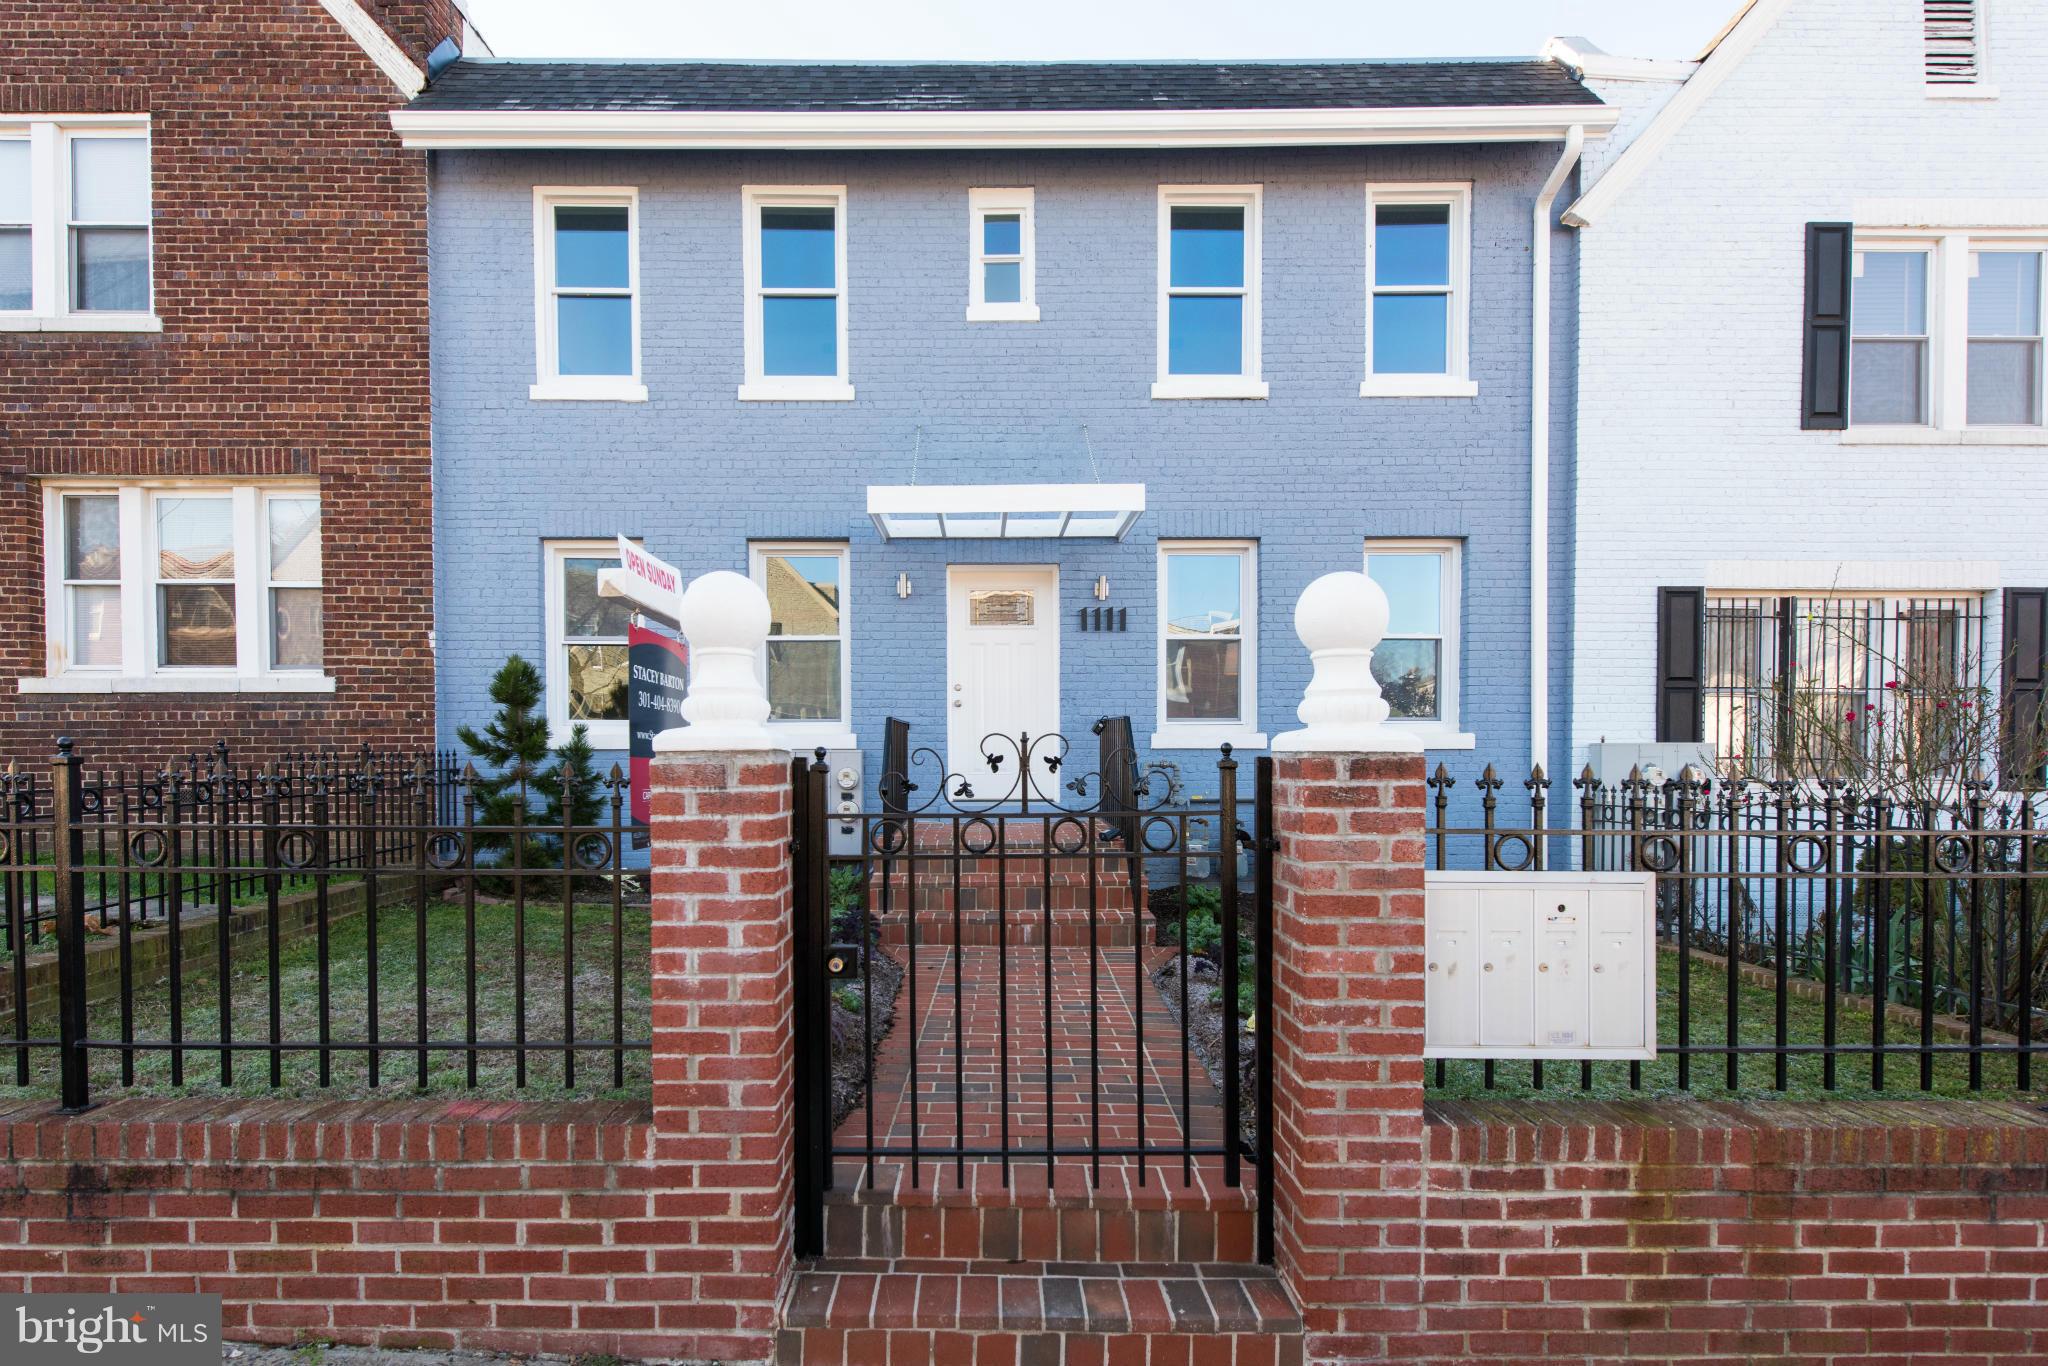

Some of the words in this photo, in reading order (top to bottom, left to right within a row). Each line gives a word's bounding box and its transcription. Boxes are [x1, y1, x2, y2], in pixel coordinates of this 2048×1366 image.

[626, 548, 646, 579] OPEN
[646, 561, 676, 594] SUNDAY
[1078, 606, 1127, 632] 1111
[633, 664, 659, 684] STACEY
[659, 672, 684, 691] BARTON
